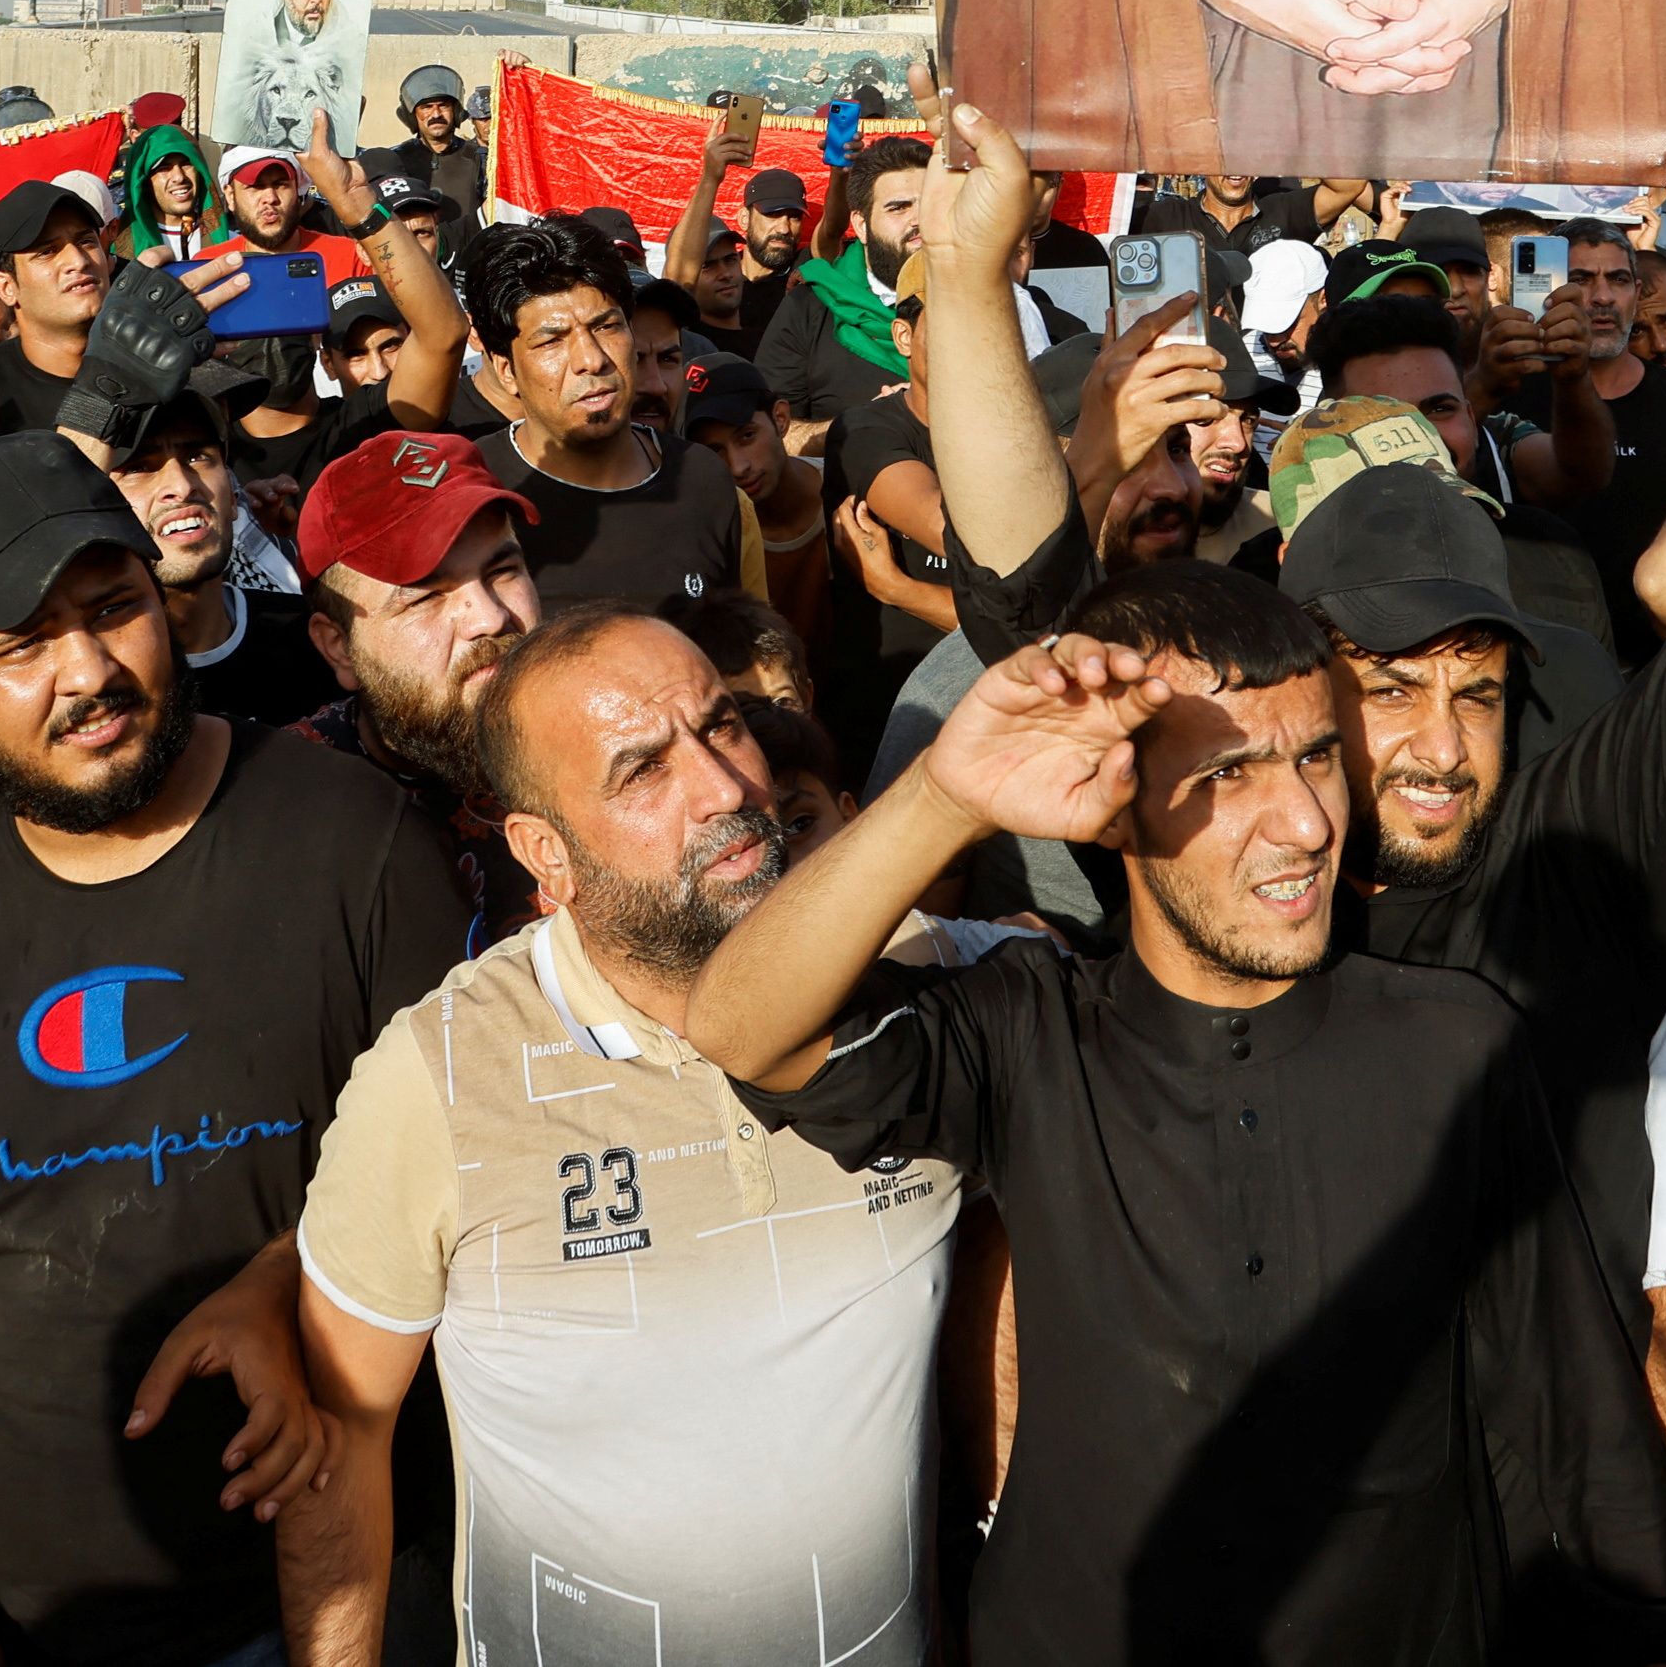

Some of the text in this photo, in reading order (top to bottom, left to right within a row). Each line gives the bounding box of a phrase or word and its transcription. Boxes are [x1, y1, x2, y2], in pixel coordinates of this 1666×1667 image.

[1373, 427, 1421, 452] 5.11
[531, 1040, 575, 1059] MAGIC
[648, 1147, 676, 1163] AND
[557, 1145, 644, 1235] 23
[863, 1176, 900, 1198] MAGIC
[868, 1181, 934, 1215] AND NETTING
